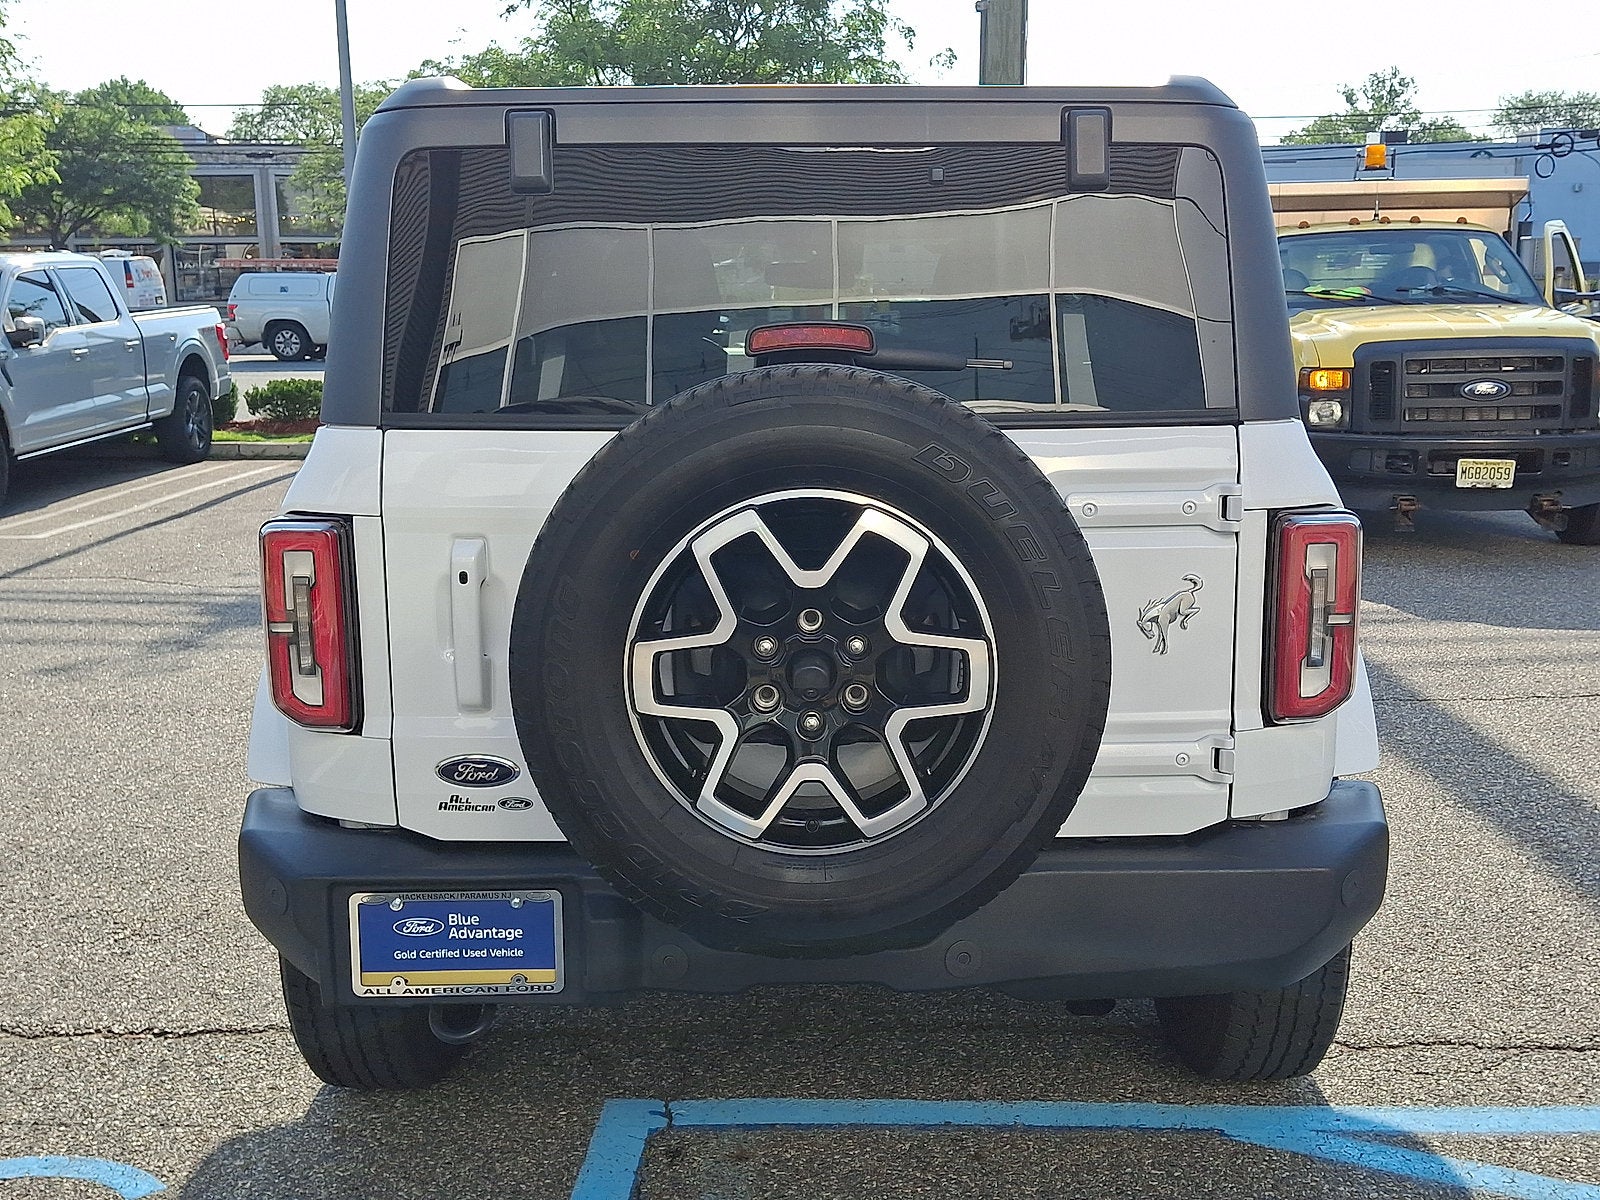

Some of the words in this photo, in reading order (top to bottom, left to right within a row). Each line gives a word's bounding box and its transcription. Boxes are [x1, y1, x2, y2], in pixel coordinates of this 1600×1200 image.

[453, 762, 499, 781] Ford
[448, 913, 480, 925] Blue
[448, 927, 523, 940] Advantage
[393, 950, 417, 960] Gold
[419, 949, 460, 959] Certified
[462, 948, 487, 958] Used
[489, 948, 524, 958] Vehicle
[363, 987, 397, 995] ALL
[402, 985, 499, 995] AMERICAN
[506, 984, 555, 993] FORD
